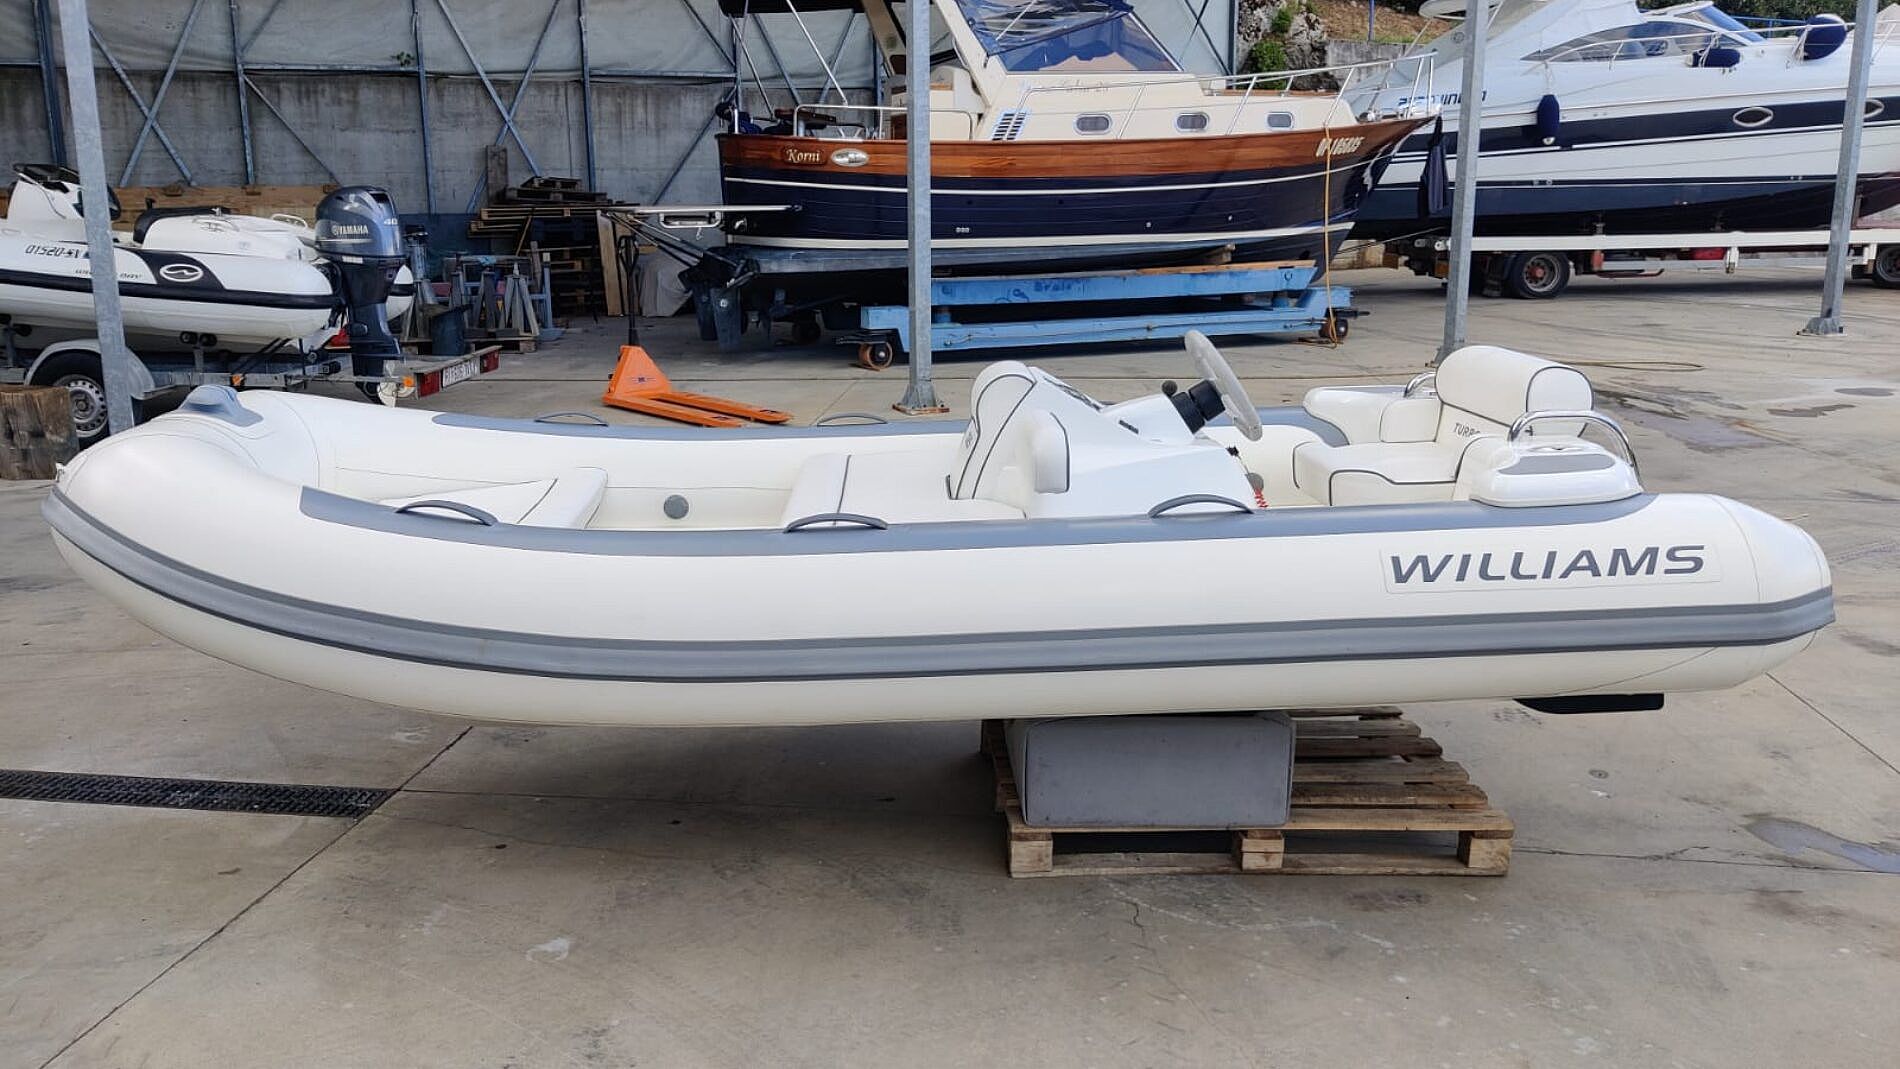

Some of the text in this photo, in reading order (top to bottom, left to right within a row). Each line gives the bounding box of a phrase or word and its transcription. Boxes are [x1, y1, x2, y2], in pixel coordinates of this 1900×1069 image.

[785, 149, 820, 163] Korni
[336, 225, 369, 235] YAMAHA
[1391, 545, 1704, 583] WILLIAMS
